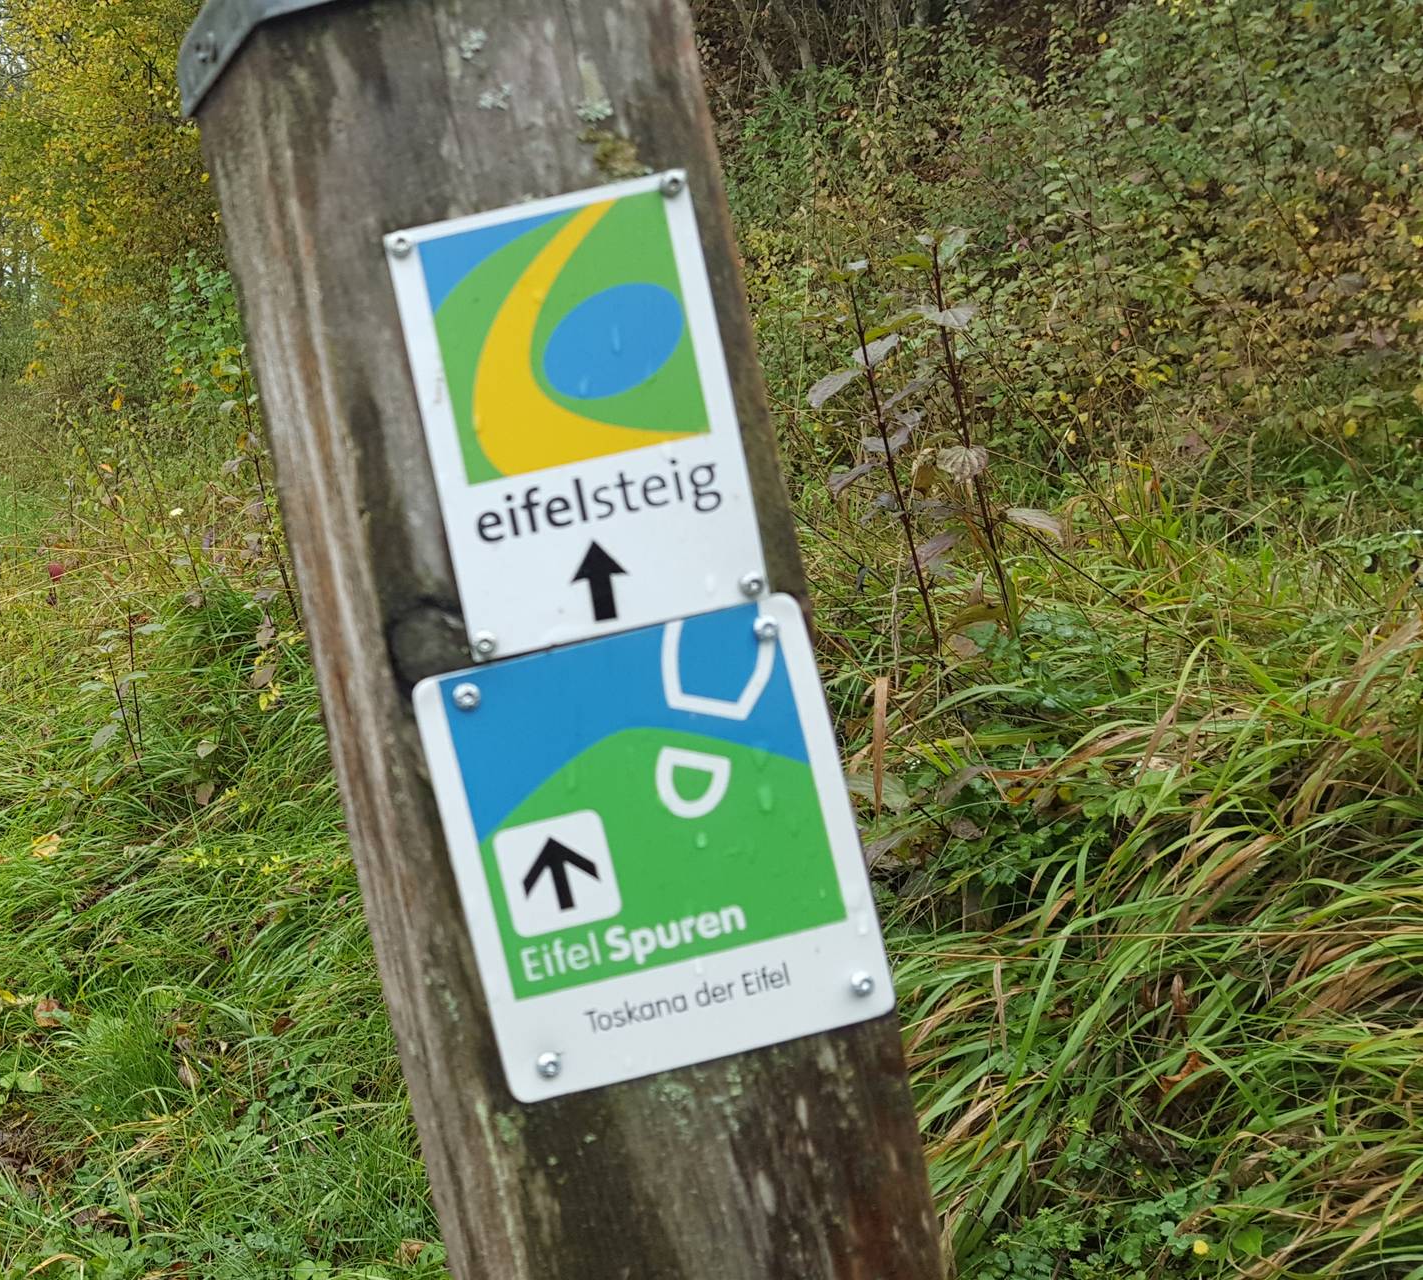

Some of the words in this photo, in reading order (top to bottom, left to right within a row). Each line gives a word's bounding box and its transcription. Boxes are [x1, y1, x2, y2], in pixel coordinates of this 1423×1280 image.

[477, 459, 722, 542] eifelsteig
[520, 932, 602, 982] Eifel
[606, 904, 746, 965] Spuren
[585, 994, 688, 1034] Toskana
[696, 981, 736, 1008] der
[742, 962, 791, 997] Eifel
